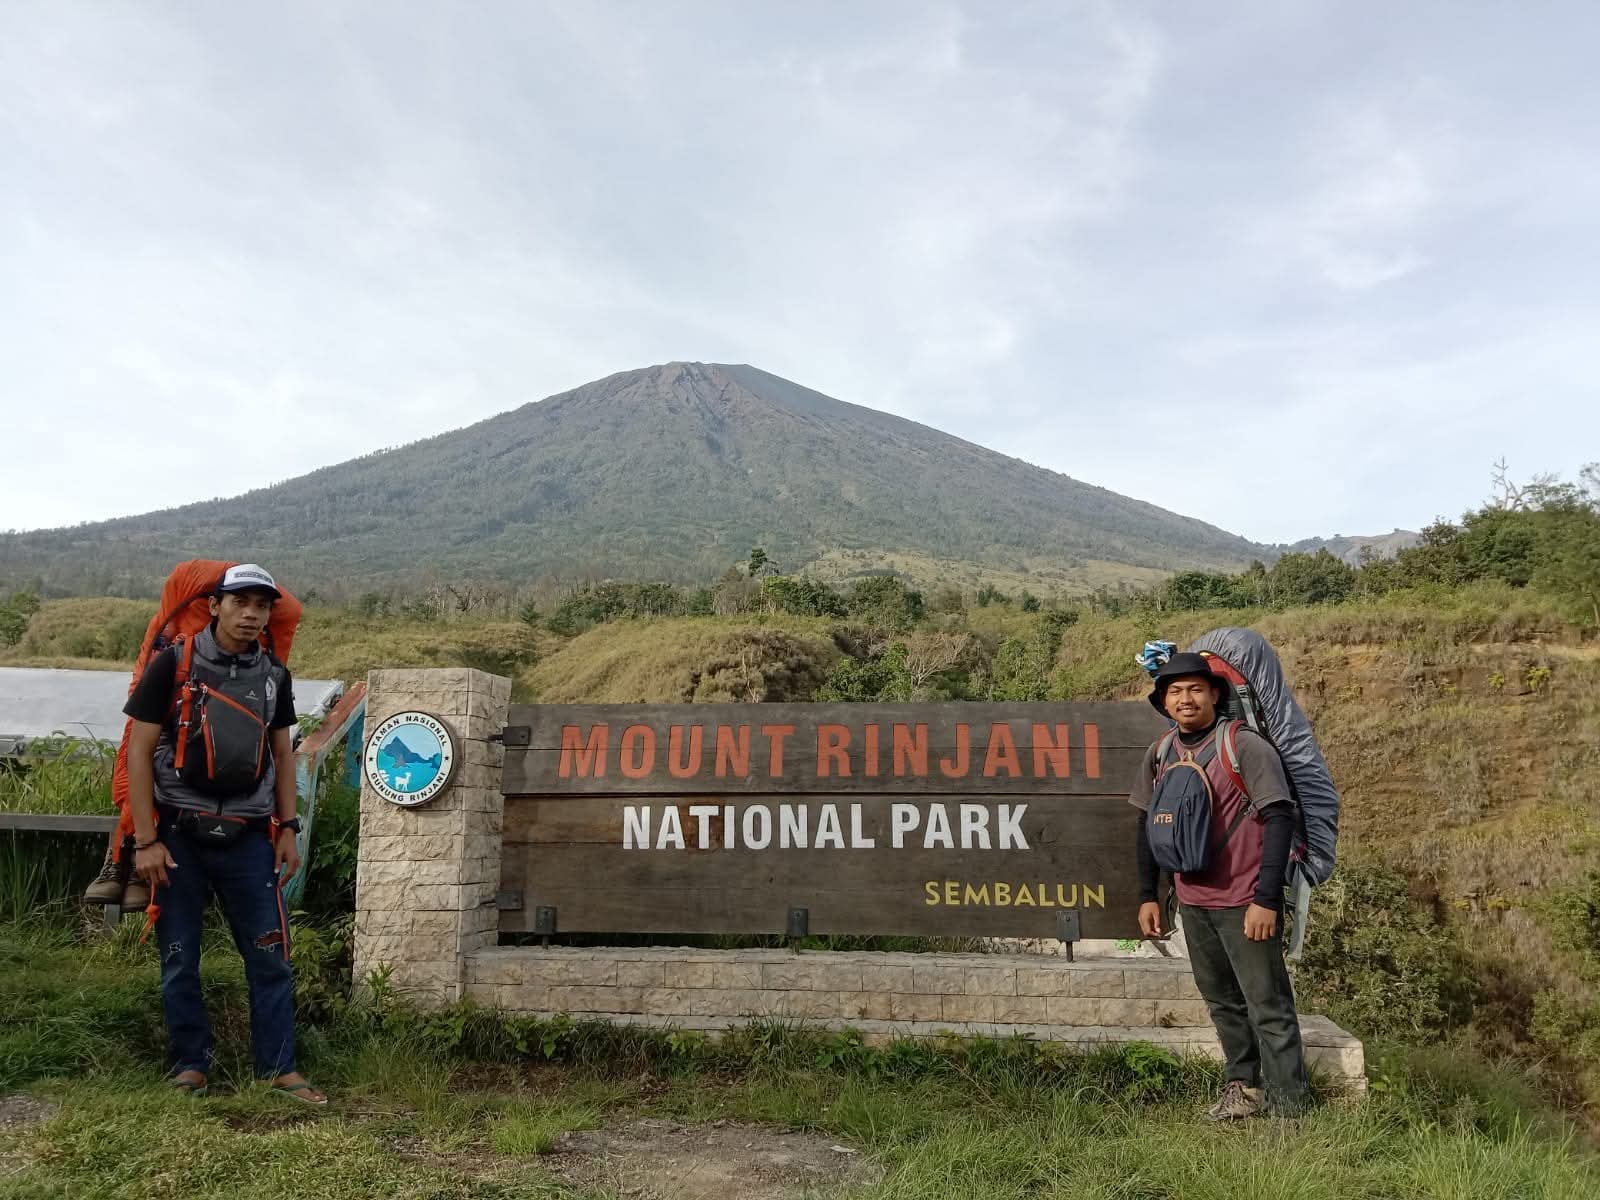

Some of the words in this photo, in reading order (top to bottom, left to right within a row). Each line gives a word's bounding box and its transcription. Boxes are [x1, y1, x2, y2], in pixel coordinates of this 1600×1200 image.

[371, 718, 400, 747] TAMAN
[405, 715, 447, 747] NASIONAL
[558, 723, 796, 778] MOUNT
[816, 722, 1102, 779] RINJANI
[371, 772, 405, 802] GUNUNG
[409, 772, 447, 801] RINJANI
[622, 803, 876, 851] NATIONAL
[891, 802, 1030, 851] PARK
[925, 881, 1106, 908] SEMBALUN
